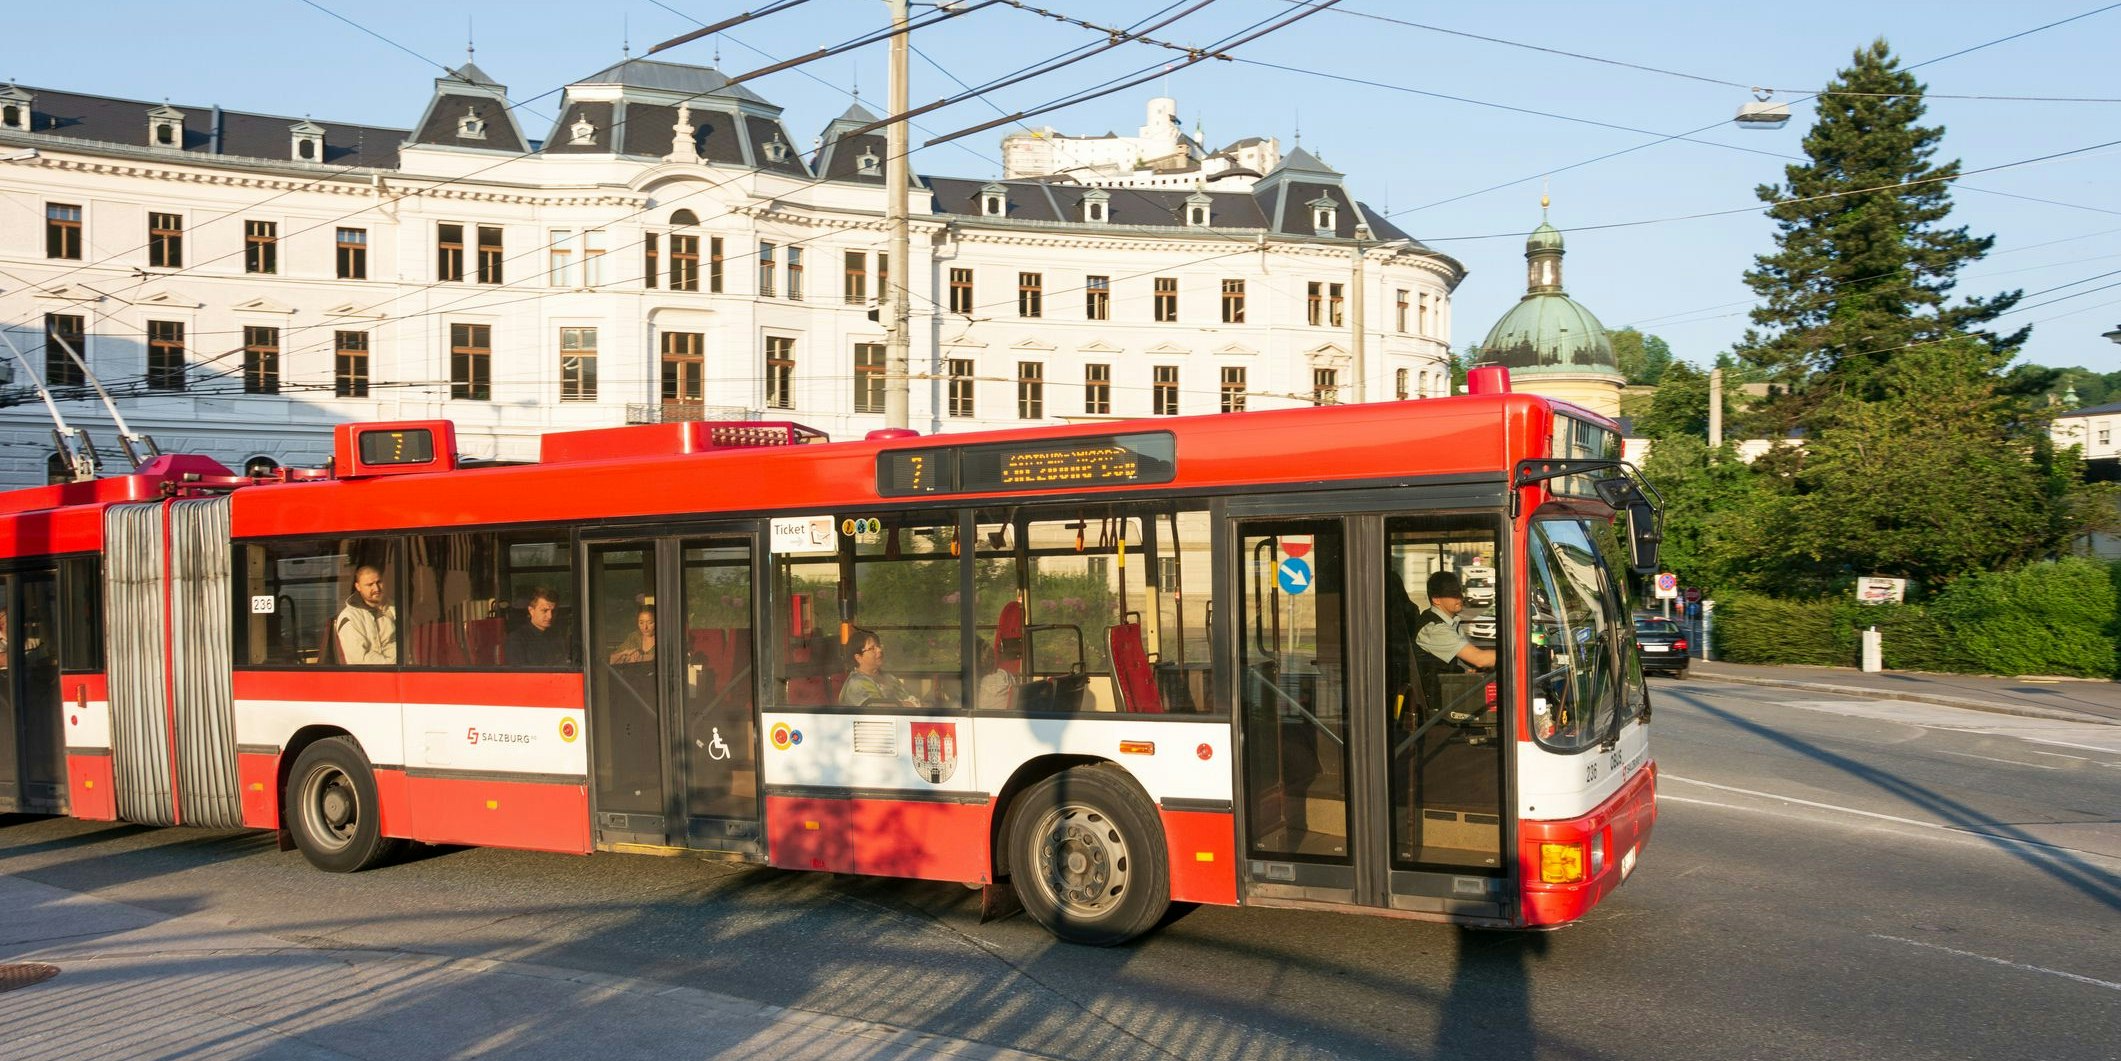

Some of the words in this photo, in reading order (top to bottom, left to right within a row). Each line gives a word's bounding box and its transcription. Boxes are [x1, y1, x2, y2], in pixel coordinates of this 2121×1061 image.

[391, 432, 403, 461] 7
[911, 456, 923, 490] 7
[774, 524, 806, 536] Ticket
[253, 598, 273, 611] 236
[481, 732, 530, 744] SALZBURG
[1585, 762, 1598, 783] 236
